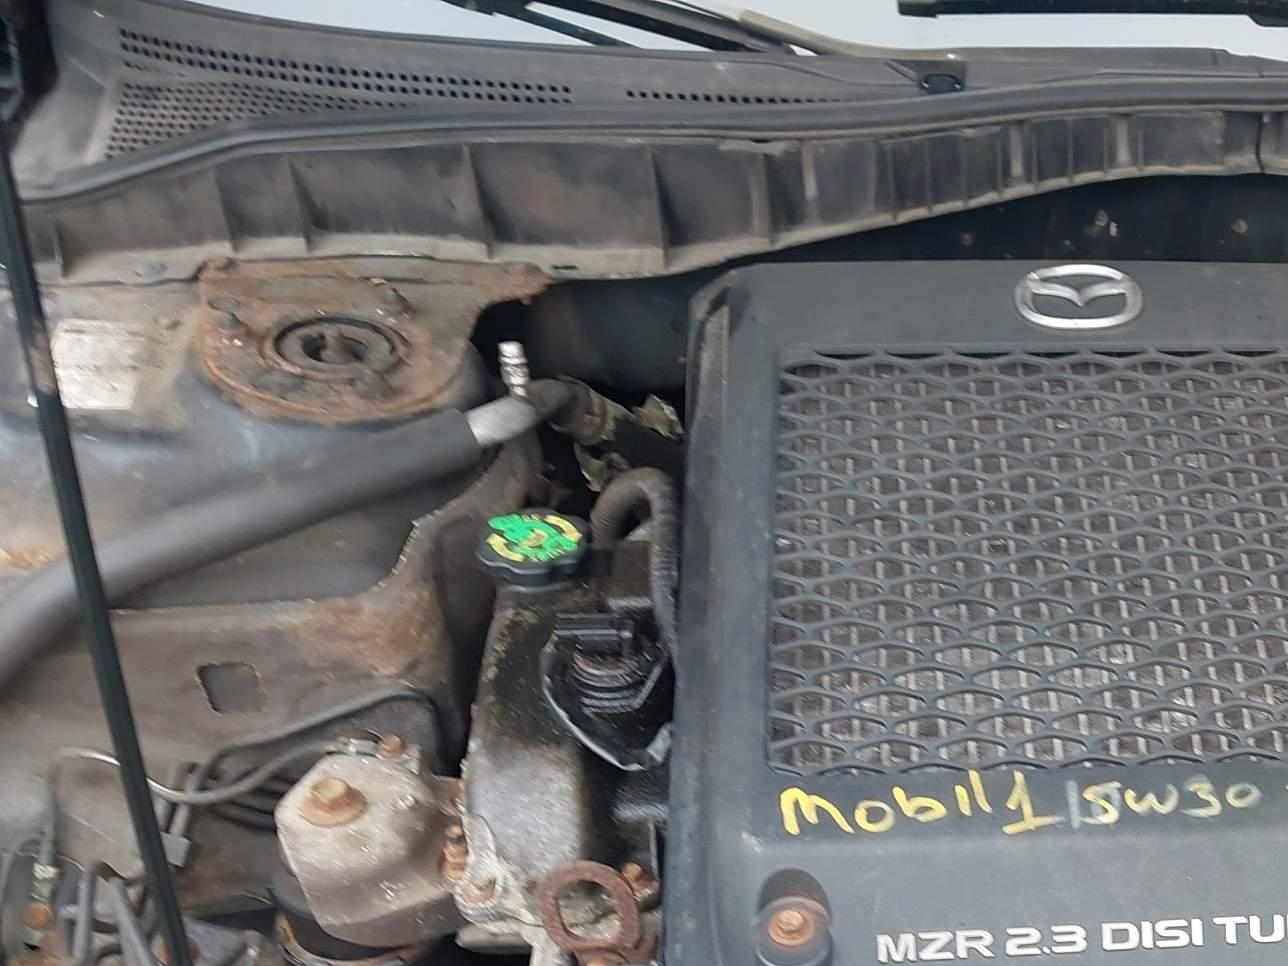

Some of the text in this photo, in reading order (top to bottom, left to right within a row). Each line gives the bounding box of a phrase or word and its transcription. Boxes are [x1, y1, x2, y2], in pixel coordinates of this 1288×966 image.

[876, 928, 995, 963] MZR
[1005, 924, 1088, 957] 2.3
[1101, 918, 1204, 951] DISI
